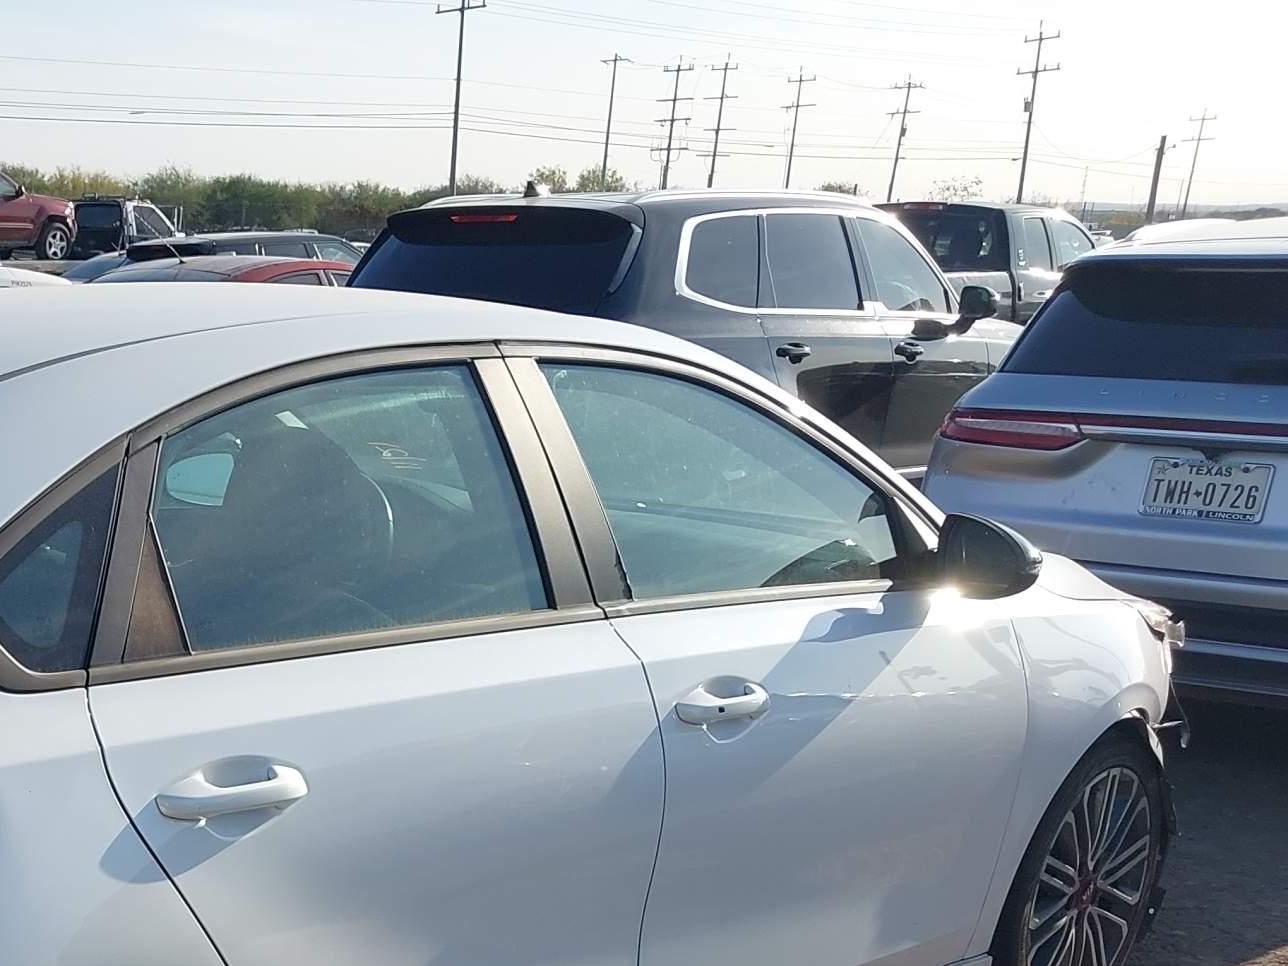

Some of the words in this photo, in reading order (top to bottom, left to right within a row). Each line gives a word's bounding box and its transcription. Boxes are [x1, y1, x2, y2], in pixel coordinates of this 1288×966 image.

[1187, 464, 1233, 477] TEXAS
[1144, 505, 1173, 515] NORTH
[1175, 507, 1199, 517] PARK
[1208, 511, 1255, 521] LINCOLN
